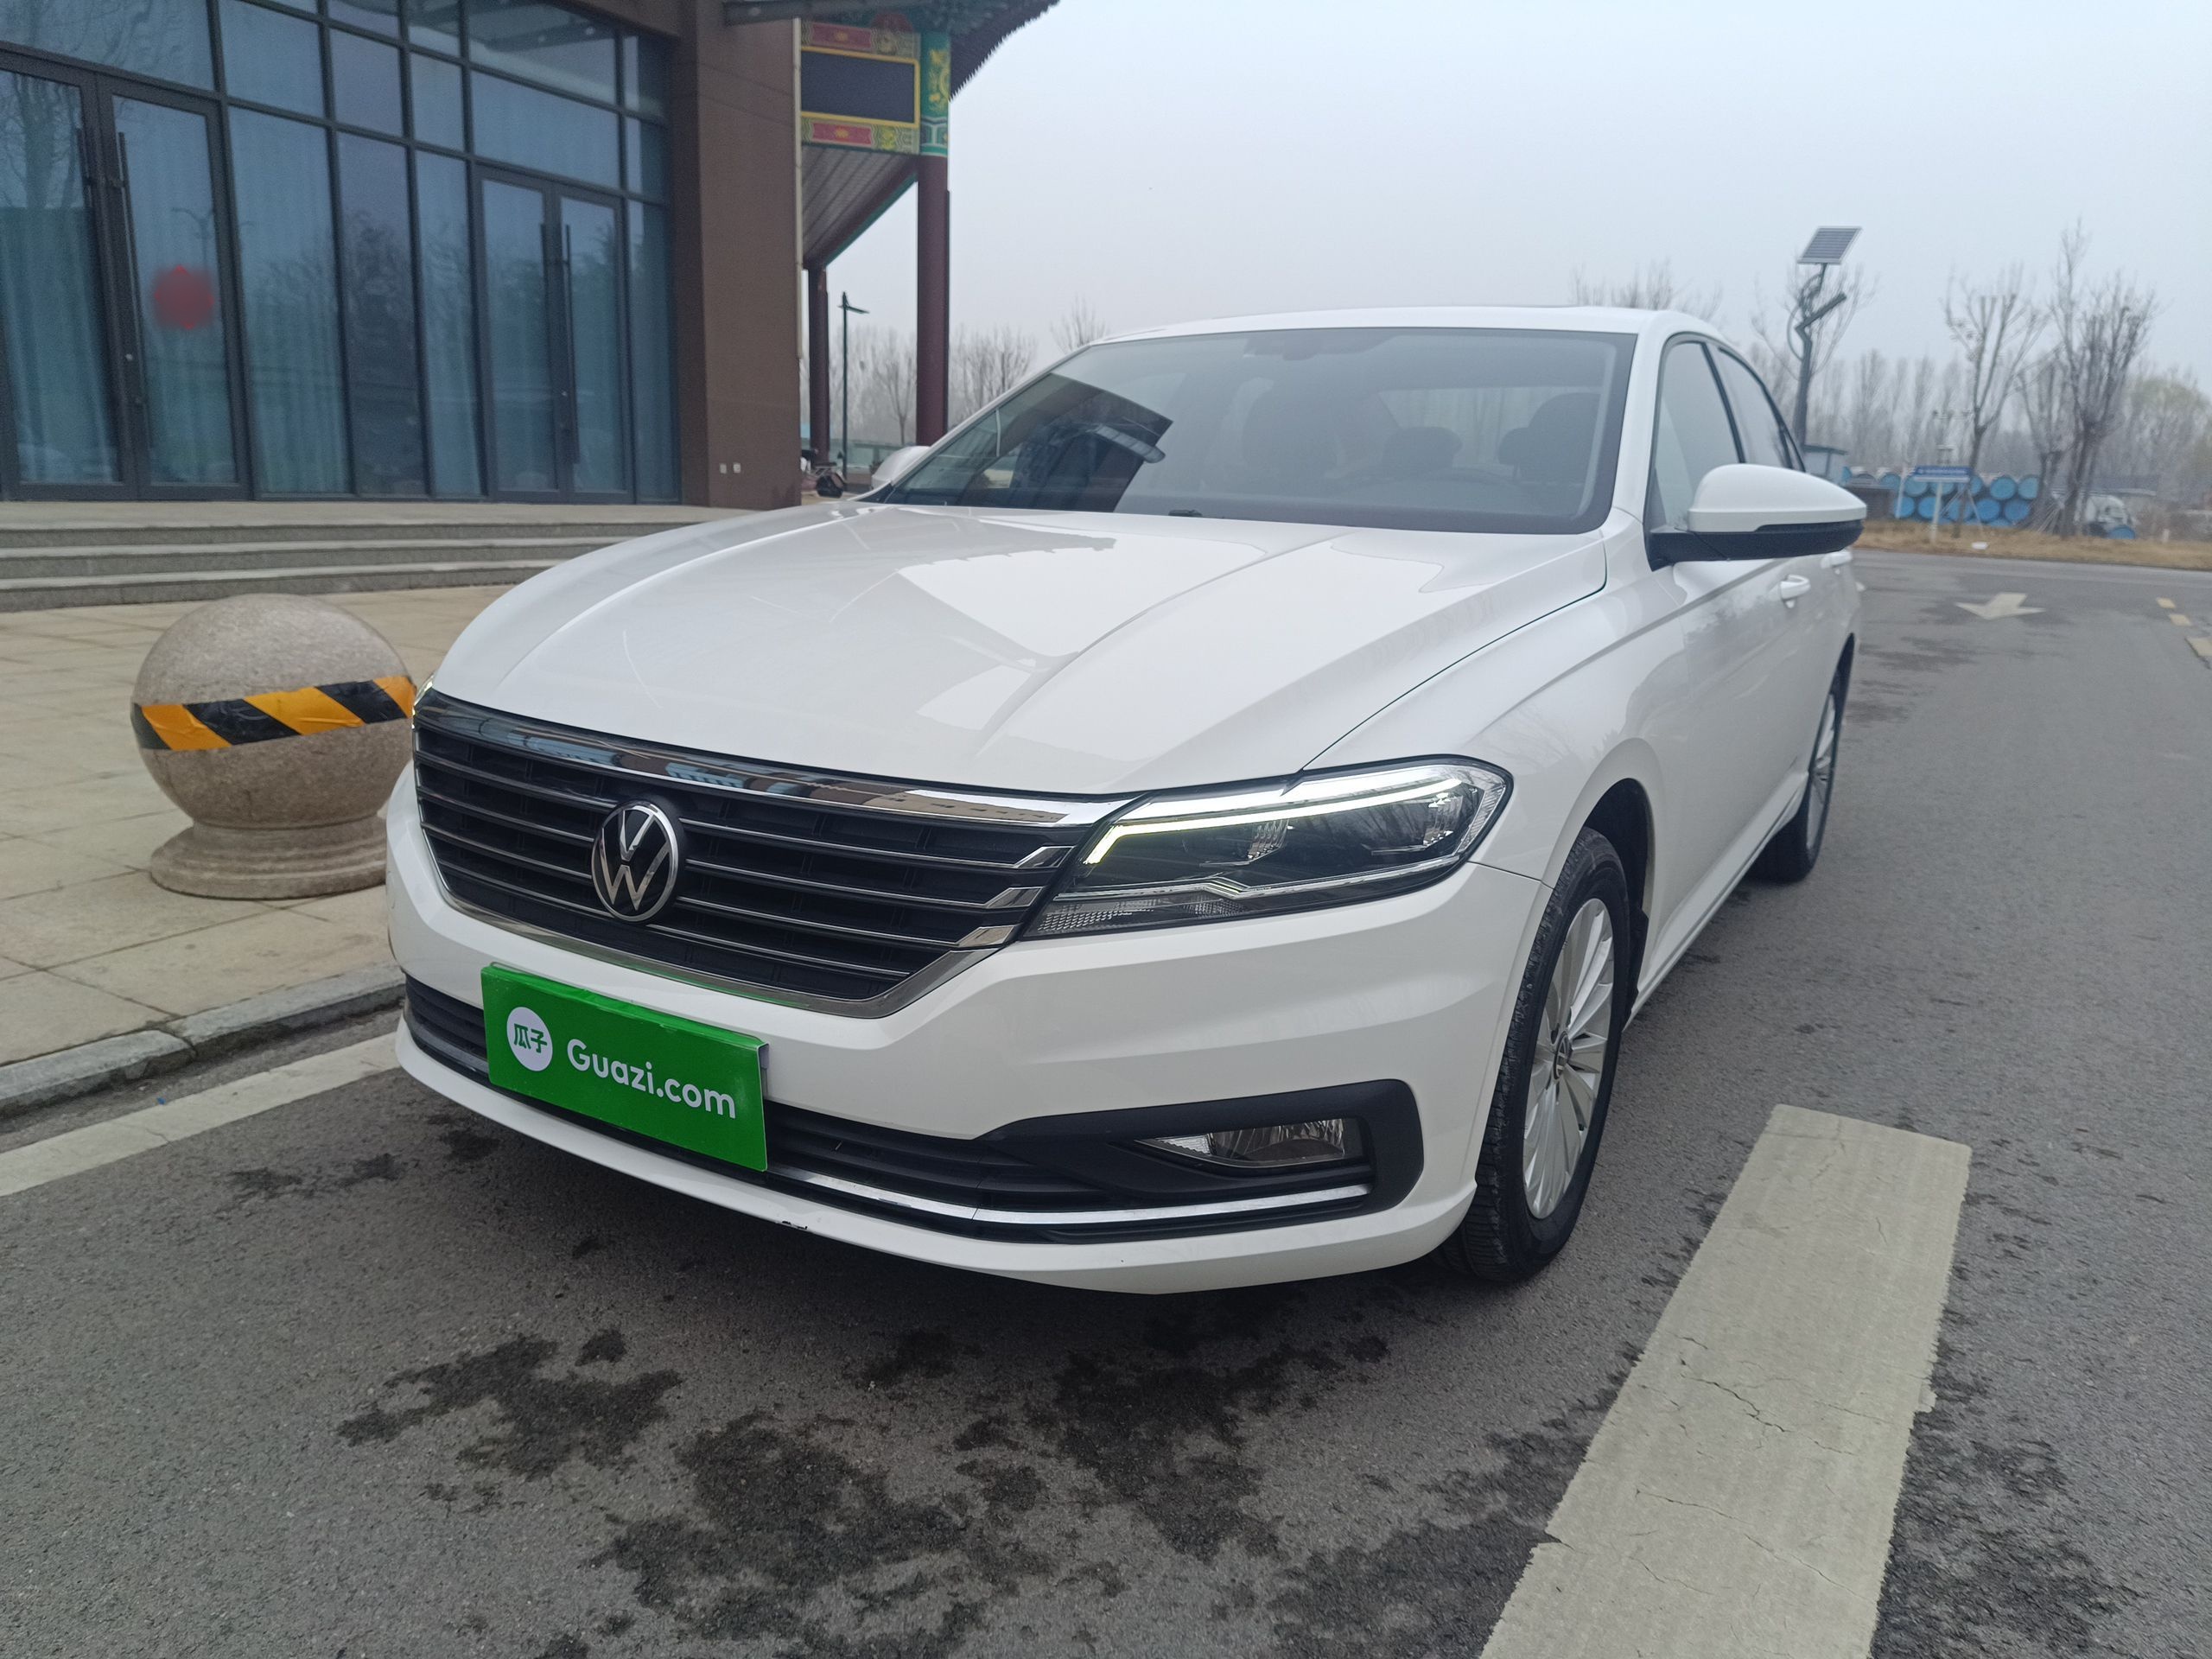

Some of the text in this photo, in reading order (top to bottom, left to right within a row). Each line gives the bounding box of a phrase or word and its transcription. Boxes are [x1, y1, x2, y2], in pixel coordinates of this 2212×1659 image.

[596, 804, 674, 912] VW
[513, 1023, 548, 1053] 瓜子
[567, 1038, 736, 1119] Guazi.com
